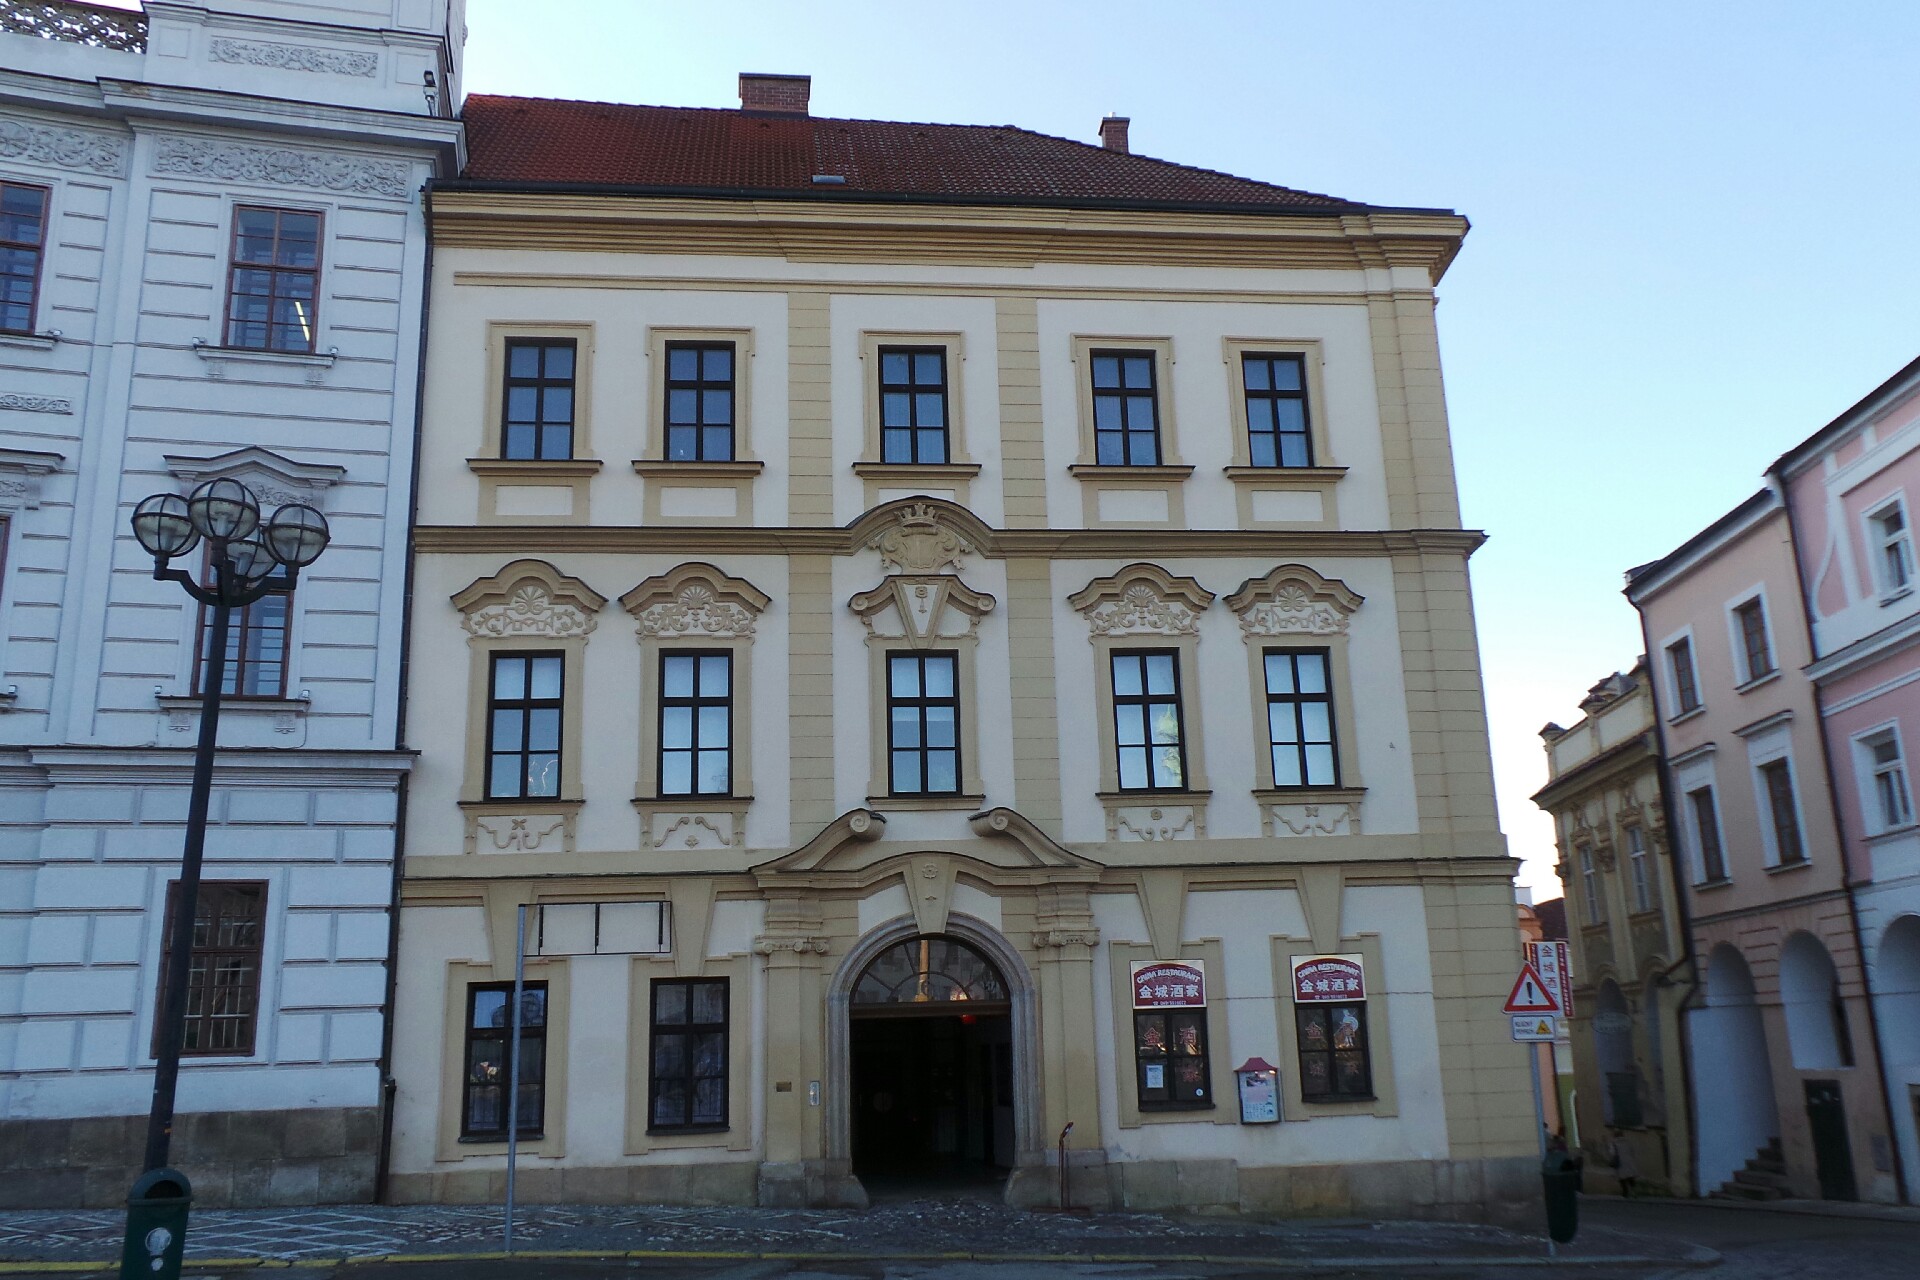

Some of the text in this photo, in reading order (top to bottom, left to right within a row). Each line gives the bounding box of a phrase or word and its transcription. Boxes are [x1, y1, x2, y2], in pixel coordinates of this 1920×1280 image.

[1137, 969, 1200, 984] CHINA RESTAURANT
[1297, 963, 1361, 978] CHINA RESTAURANT
[1138, 984, 1199, 999] 金城酒家
[1300, 978, 1360, 993] 金城酒家
